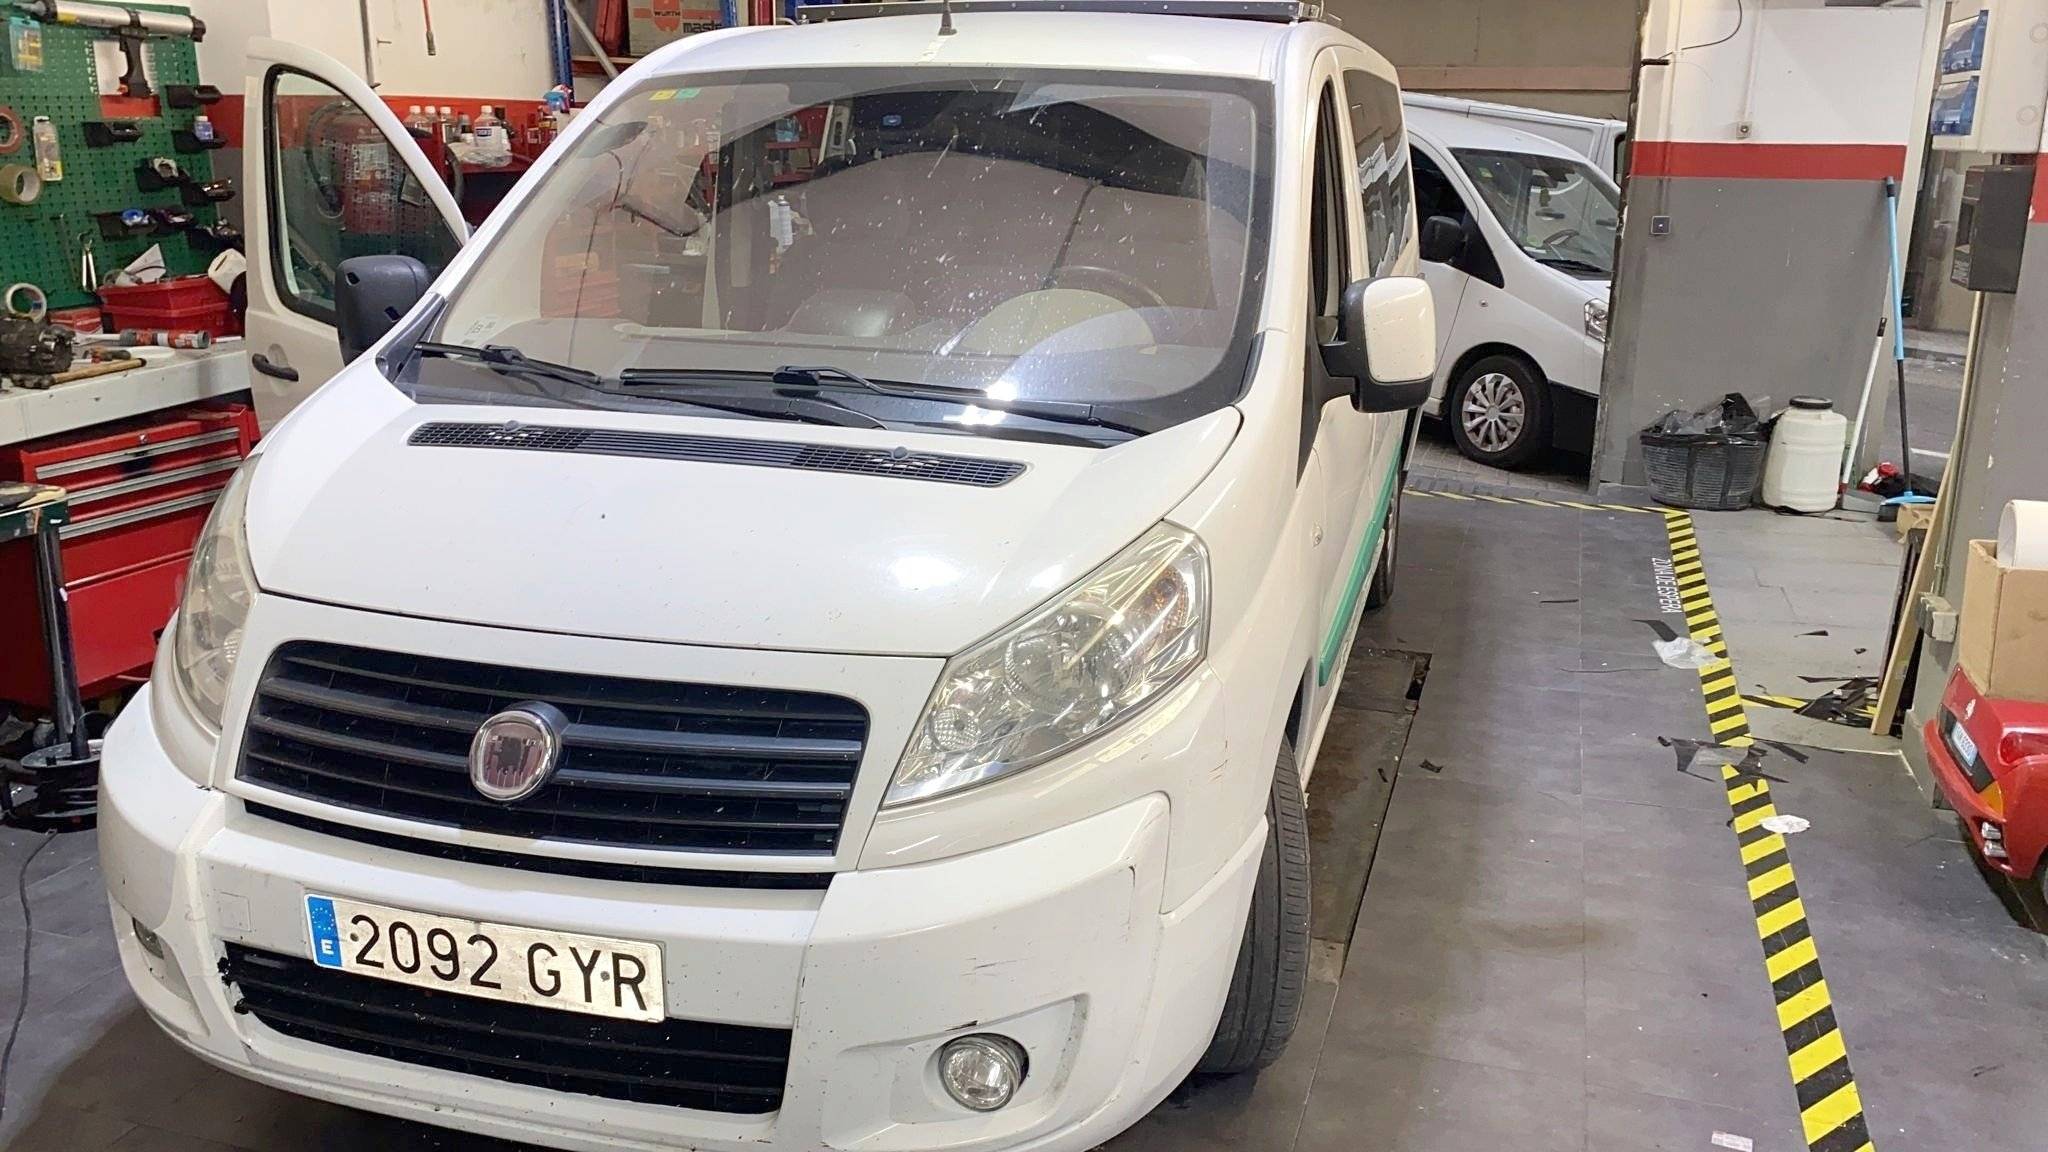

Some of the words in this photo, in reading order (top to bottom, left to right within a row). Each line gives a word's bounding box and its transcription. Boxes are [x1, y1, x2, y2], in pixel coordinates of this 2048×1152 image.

[1656, 576, 1676, 585] DE
[1657, 586, 1682, 613] ESPERA
[321, 939, 335, 955] E
[350, 914, 502, 990] 2092
[526, 941, 648, 1011] GYR
